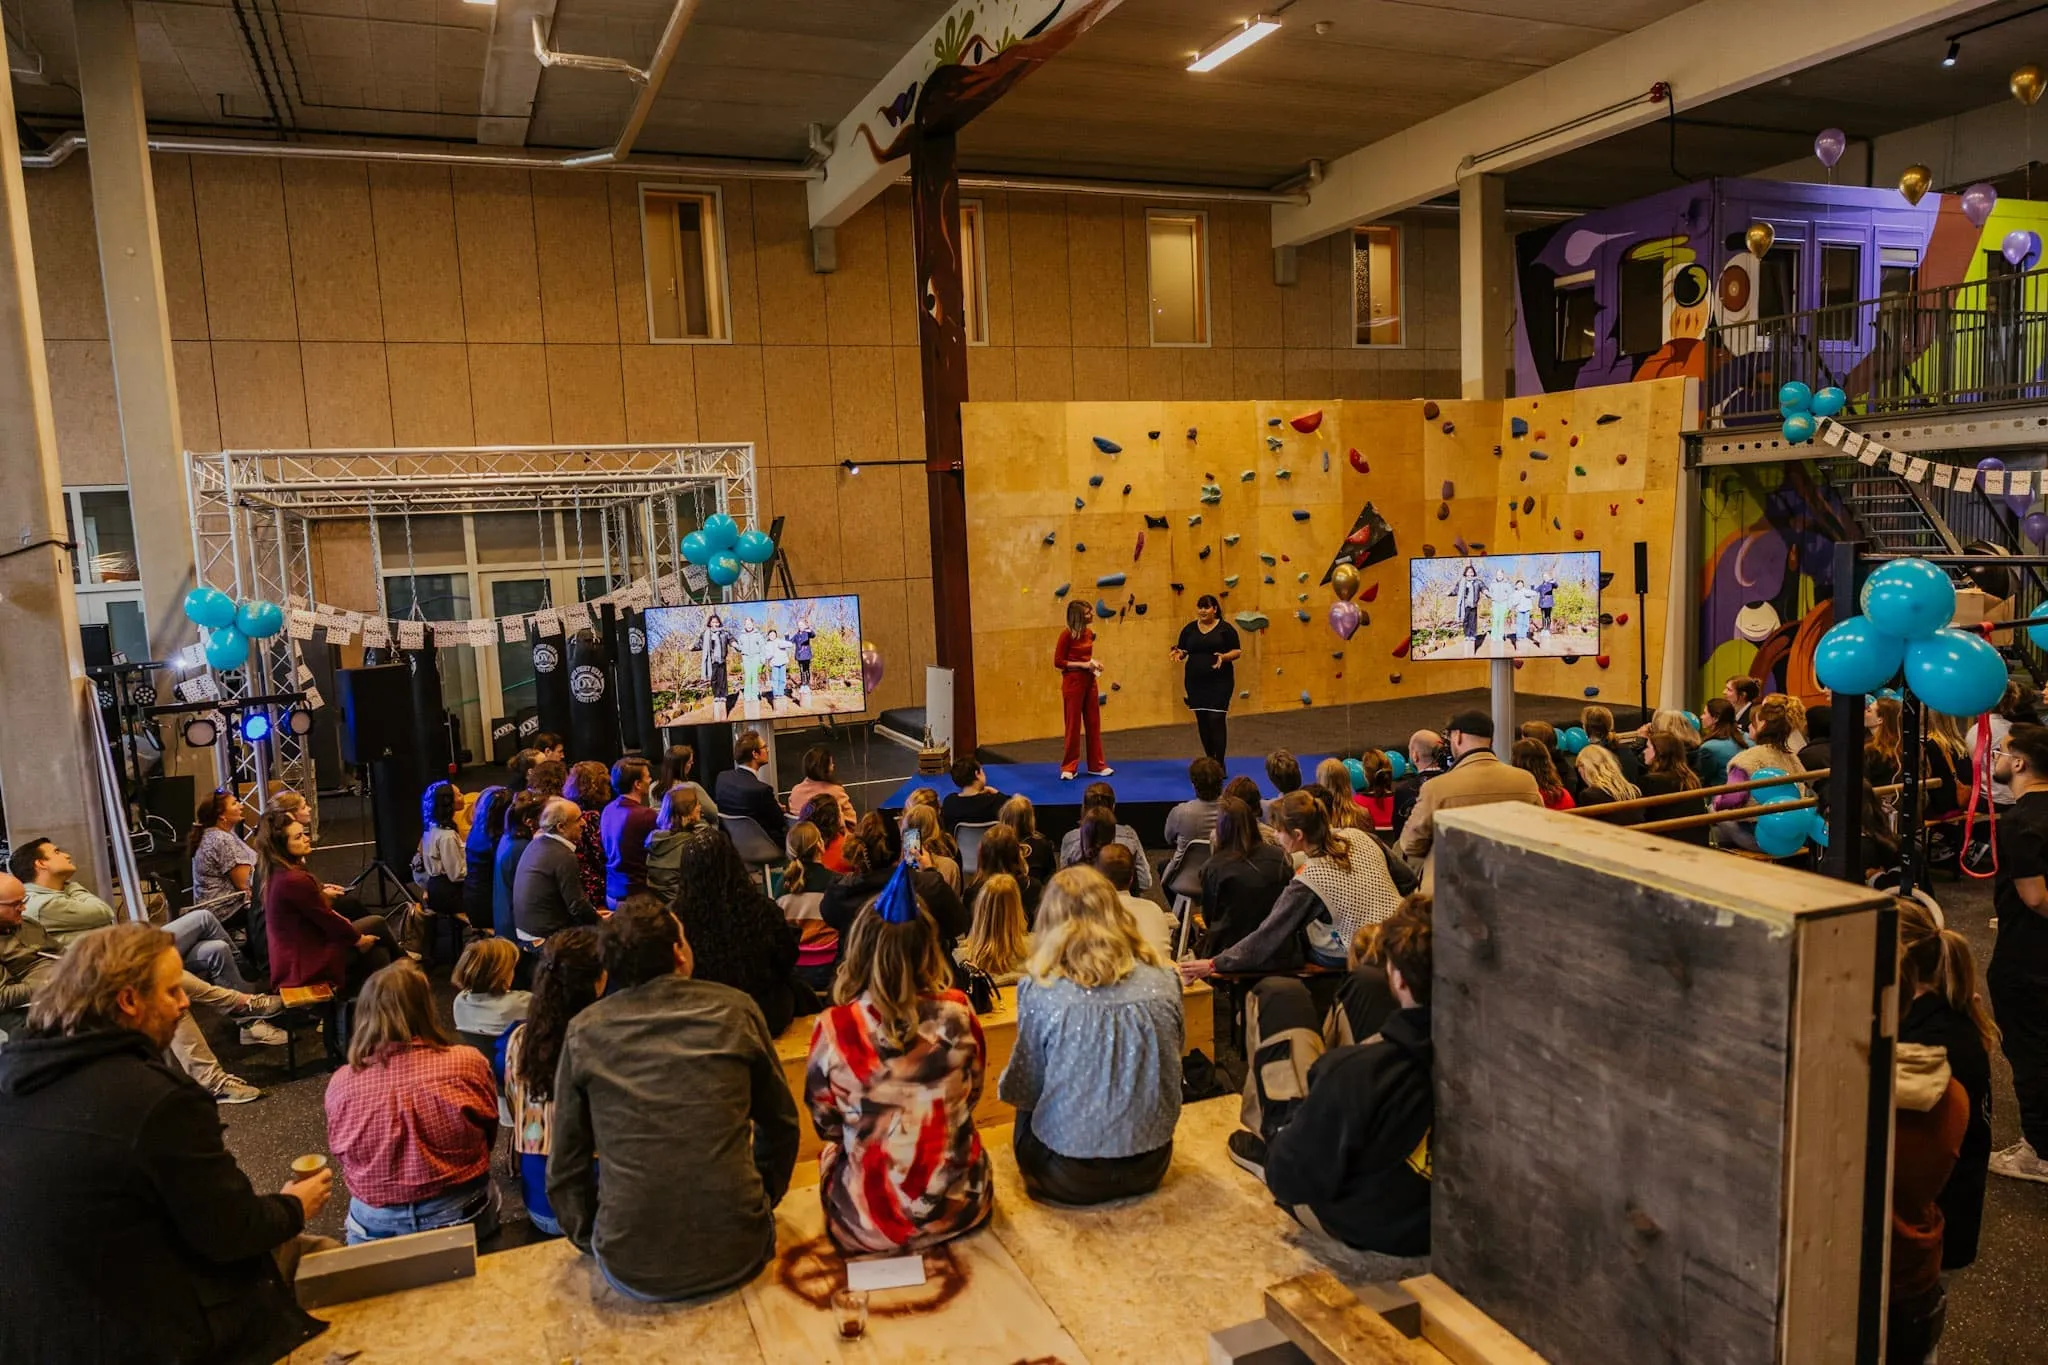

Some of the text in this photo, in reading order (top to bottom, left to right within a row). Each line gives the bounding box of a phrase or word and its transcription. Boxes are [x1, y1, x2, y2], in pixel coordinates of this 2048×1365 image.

[293, 619, 311, 627] MOVE
[330, 625, 348, 633] MOVE
[366, 629, 383, 637] MOVE
[574, 678, 602, 691] JOYA
[493, 722, 516, 740] JOYA
